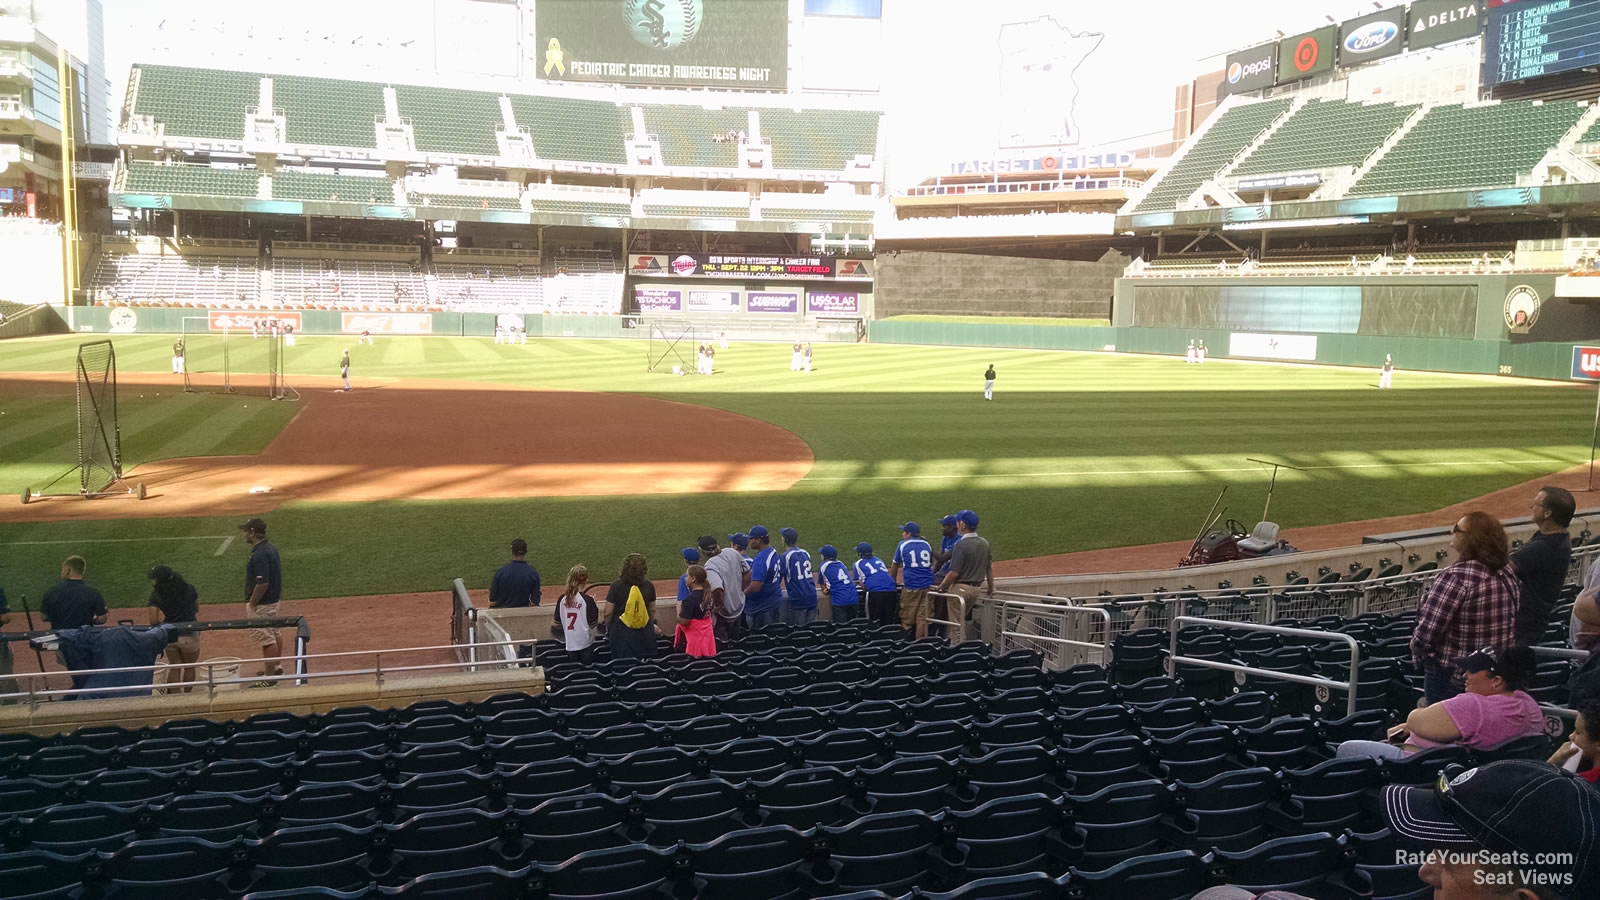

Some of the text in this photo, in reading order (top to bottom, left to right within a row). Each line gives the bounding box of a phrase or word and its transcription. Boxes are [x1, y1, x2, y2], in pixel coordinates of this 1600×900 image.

[1428, 5, 1477, 28] DELTA
[1517, 12, 1521, 21] E
[1524, 0, 1569, 18] ENCARNACION
[1504, 15, 1547, 33] 2 A PUJOLS
[1353, 31, 1386, 49] Ford
[1515, 31, 1520, 40] D
[1522, 26, 1541, 38] ORTIZ
[1514, 41, 1520, 50] M
[1522, 34, 1548, 48] TRUMBO
[1514, 51, 1519, 59] M
[1521, 46, 1541, 58] BETTS
[1242, 56, 1272, 78] pepsi
[1502, 52, 1559, 72] 6 J DONALDSON
[571, 61, 770, 81] PEDIATRIC CANCER AWARENESS NIGHT
[1501, 65, 1544, 81] 7 C CORREA
[952, 152, 1136, 174] TARGET FIELD
[723, 256, 745, 264] SPORTS
[807, 258, 820, 266] FAIR
[749, 296, 796, 307] SUBWAY
[1499, 365, 1512, 373] 365
[865, 560, 888, 575] 13
[908, 550, 931, 568] 19
[794, 560, 813, 580] 12
[838, 568, 850, 584] 4
[567, 613, 577, 630] 7
